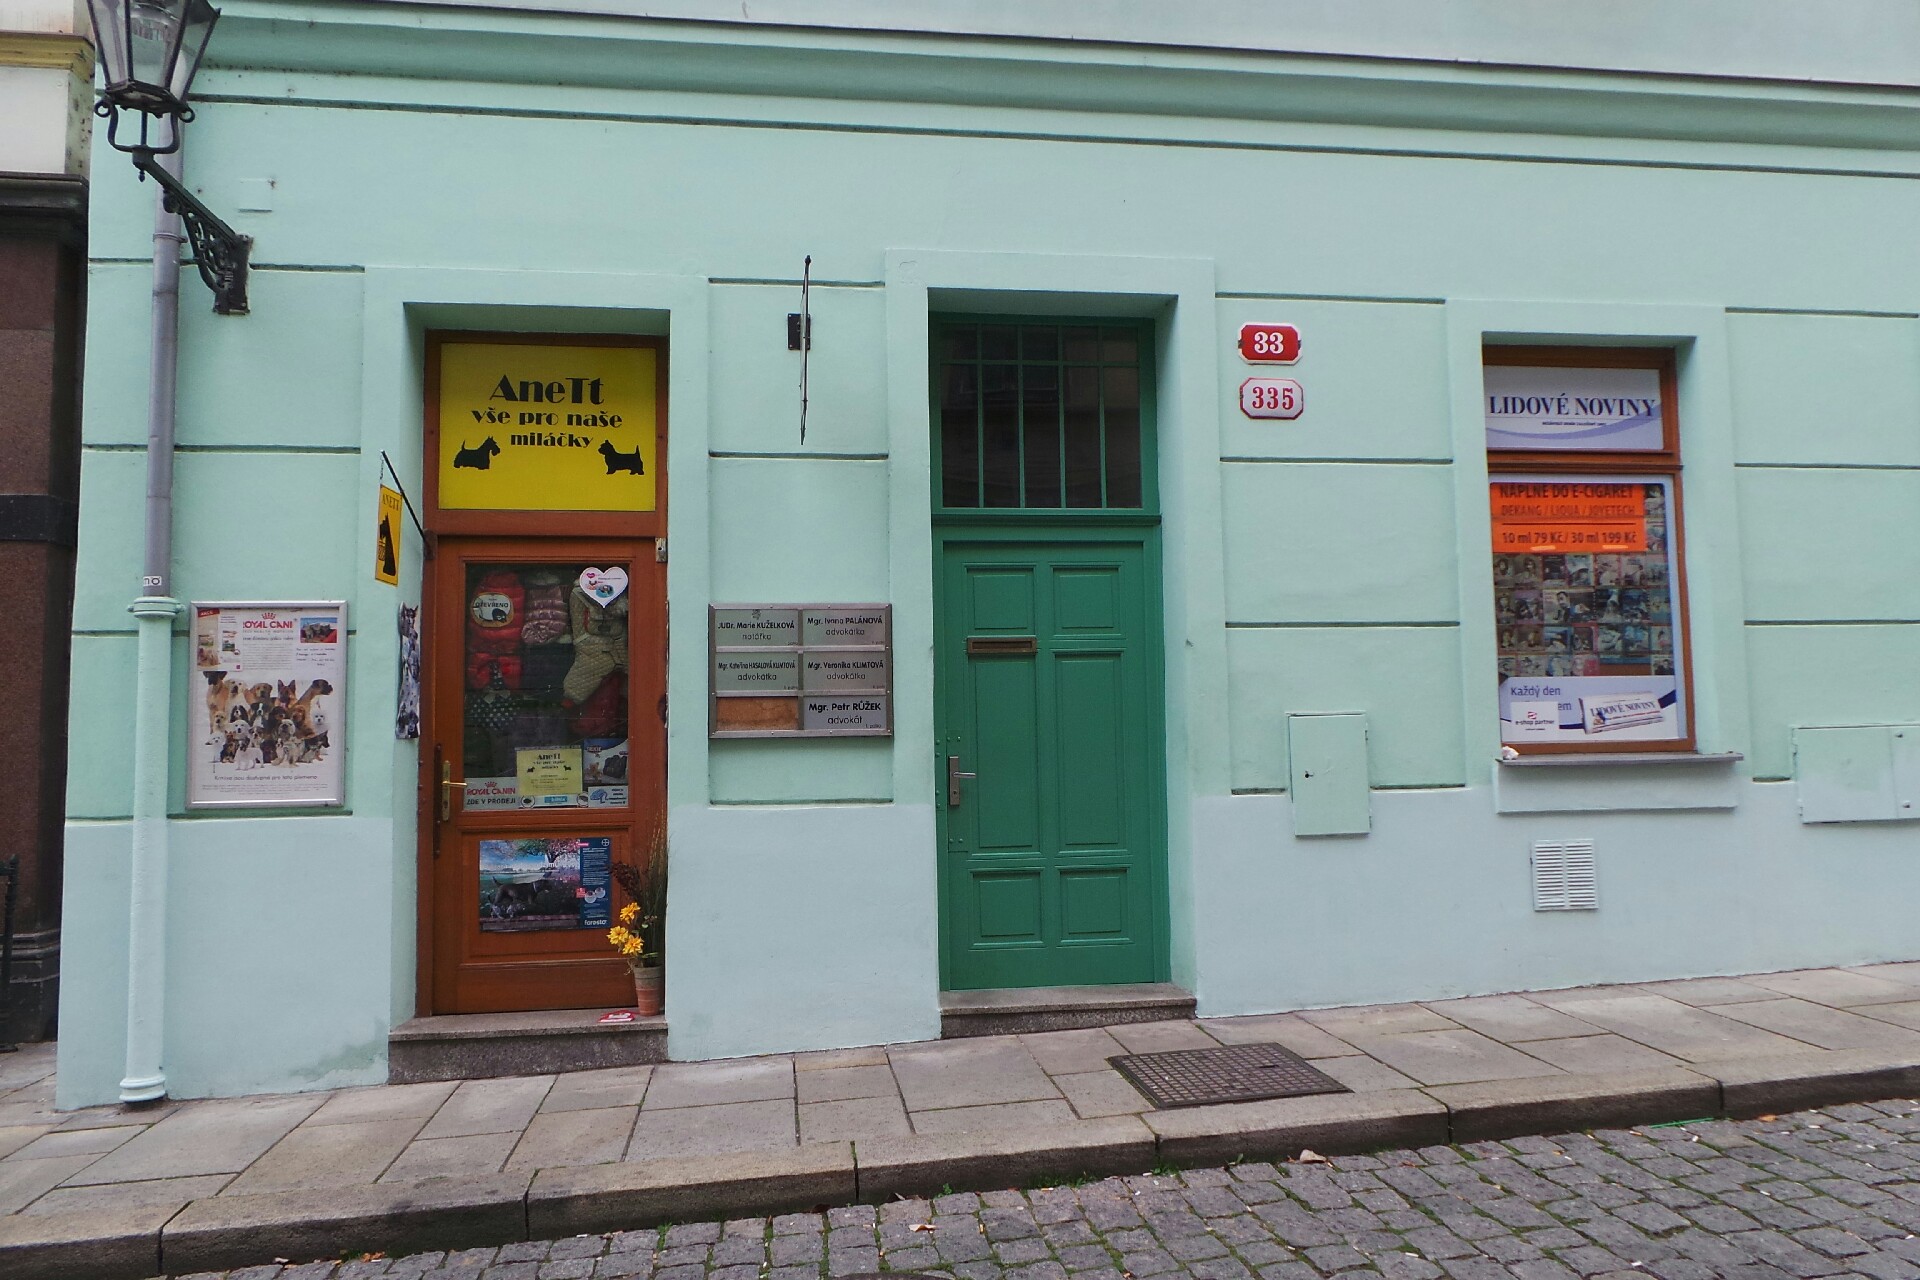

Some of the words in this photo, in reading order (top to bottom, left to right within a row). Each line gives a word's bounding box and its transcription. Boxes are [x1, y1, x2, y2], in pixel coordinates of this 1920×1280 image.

[1254, 332, 1284, 354] 33
[1252, 386, 1294, 410] 335
[1490, 393, 1570, 416] LIDOVÉ
[1574, 398, 1656, 416] NOVINY
[472, 407, 511, 424] vše
[518, 412, 560, 426] pro
[566, 410, 622, 428] naše
[510, 431, 594, 448] miláčky
[1552, 484, 1568, 498] DO
[1573, 484, 1634, 498] E-CIGARET
[1502, 532, 1514, 544] 10
[1518, 532, 1532, 544] ml
[1534, 532, 1548, 544] 79
[1572, 532, 1584, 544] 30
[1586, 532, 1600, 544] ml
[1602, 532, 1622, 544] 199
[1624, 531, 1636, 544] Kč
[736, 620, 756, 629] Marie
[756, 620, 794, 629] KUŽELKOVÁ
[807, 618, 824, 626] Mgr.
[846, 616, 882, 624] PALÁNOVÁ
[742, 632, 772, 640] notářka
[826, 627, 864, 636] advokátka
[808, 662, 822, 670] Mgr.
[852, 660, 884, 668] KLIMTOVÁ
[738, 672, 777, 681] advokátka
[826, 672, 866, 680] advokátka
[1510, 686, 1540, 698] Každý
[1542, 687, 1560, 696] den
[808, 702, 828, 713] Mgr.
[832, 702, 850, 711] Petr
[852, 700, 882, 710] RŮŽEK
[1624, 701, 1656, 714] NOVINY
[828, 715, 862, 724] advokát
[1516, 718, 1534, 726] e-shop
